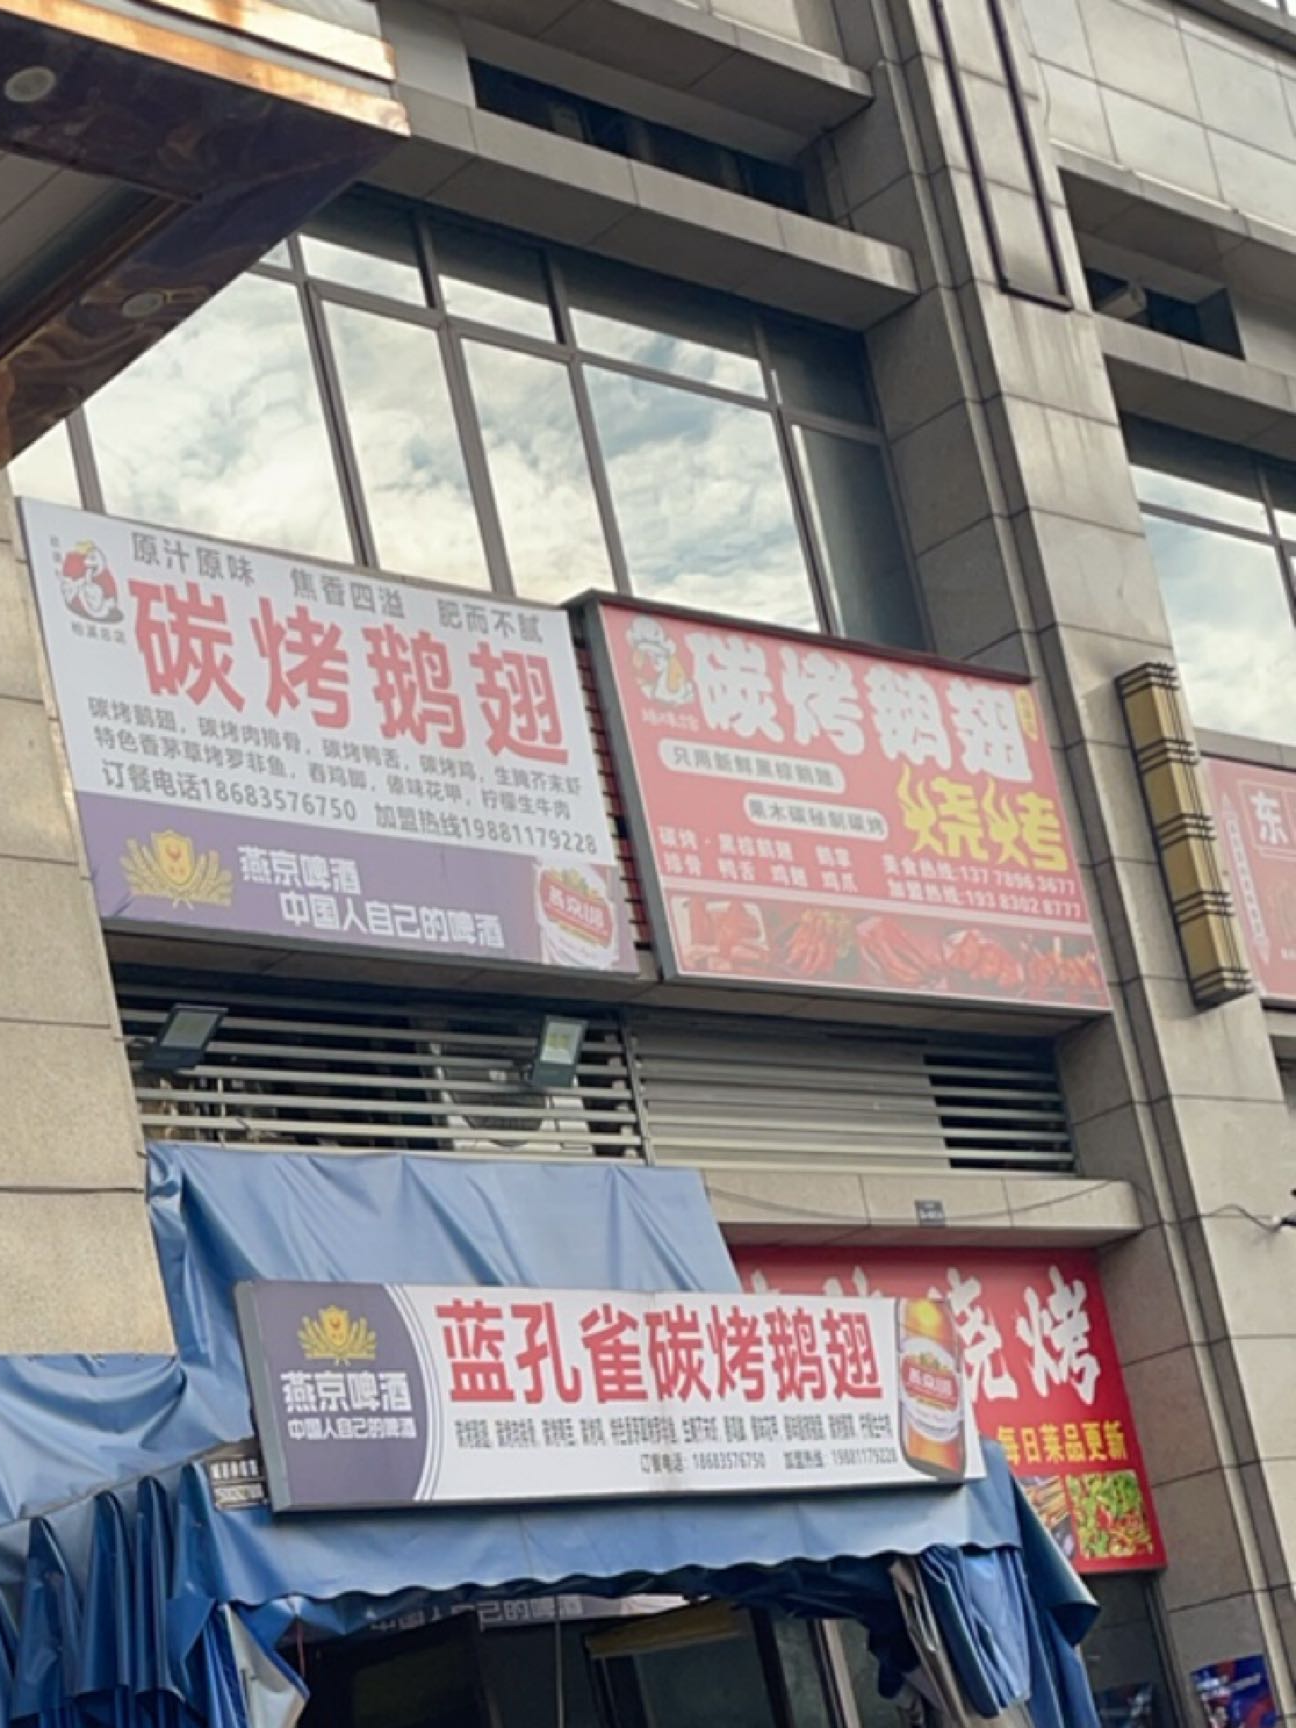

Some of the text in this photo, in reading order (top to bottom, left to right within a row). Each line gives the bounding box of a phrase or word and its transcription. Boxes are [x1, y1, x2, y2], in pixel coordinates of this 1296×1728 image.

[131, 531, 255, 587] 原汁原味
[290, 566, 405, 619] 焦香四溢
[127, 577, 569, 765] 碳烤鹅翅
[684, 630, 1033, 783] 碳烤鹅翅
[897, 761, 1069, 872] 烧烤
[237, 845, 362, 896] 燕京啤酒
[280, 891, 504, 950] 中国人自己的啤酒
[280, 1370, 413, 1413] 燕京啤酒
[435, 1298, 884, 1404] 蓝孔雀碳烤鹅翅
[287, 1416, 417, 1440] 中国人自己的啤酒
